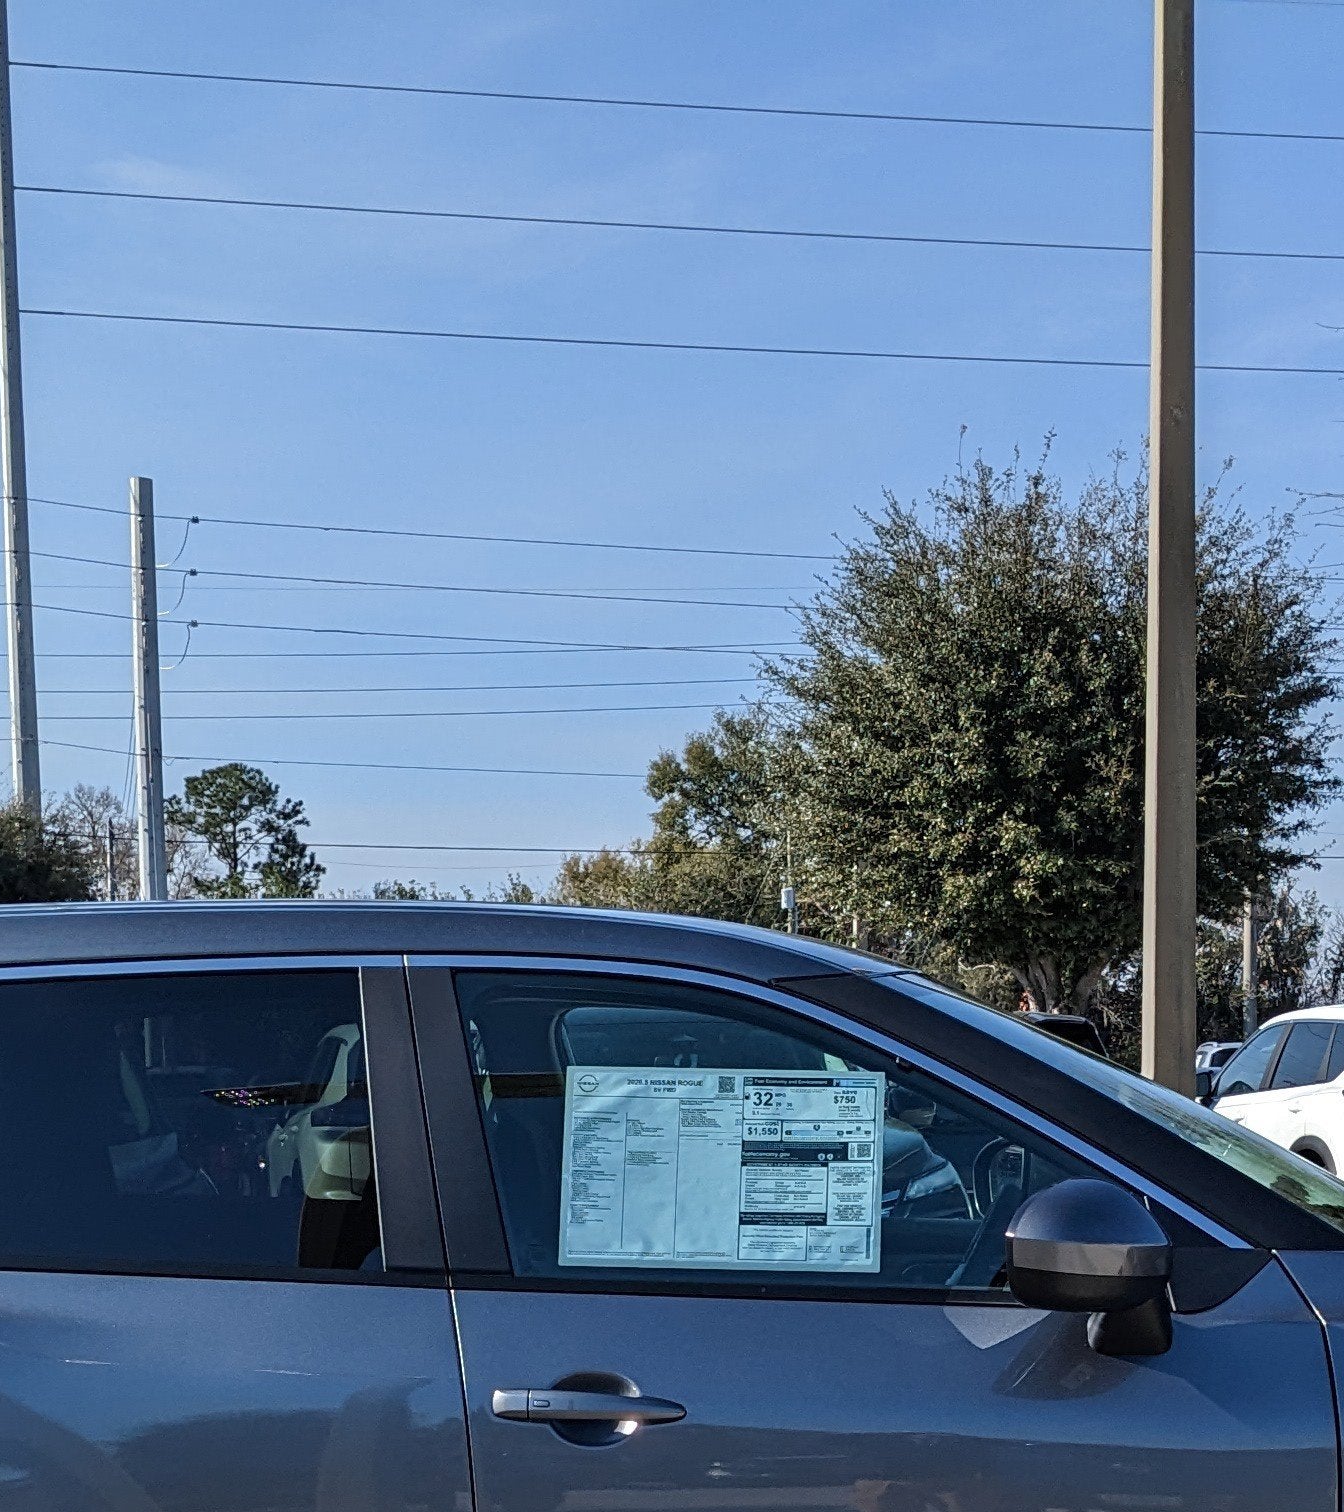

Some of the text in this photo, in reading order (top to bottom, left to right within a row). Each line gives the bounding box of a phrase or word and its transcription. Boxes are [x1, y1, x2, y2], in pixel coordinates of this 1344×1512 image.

[753, 1091, 773, 1106] 32
[833, 1095, 856, 1104] $750
[747, 1127, 778, 1136] $1,550
